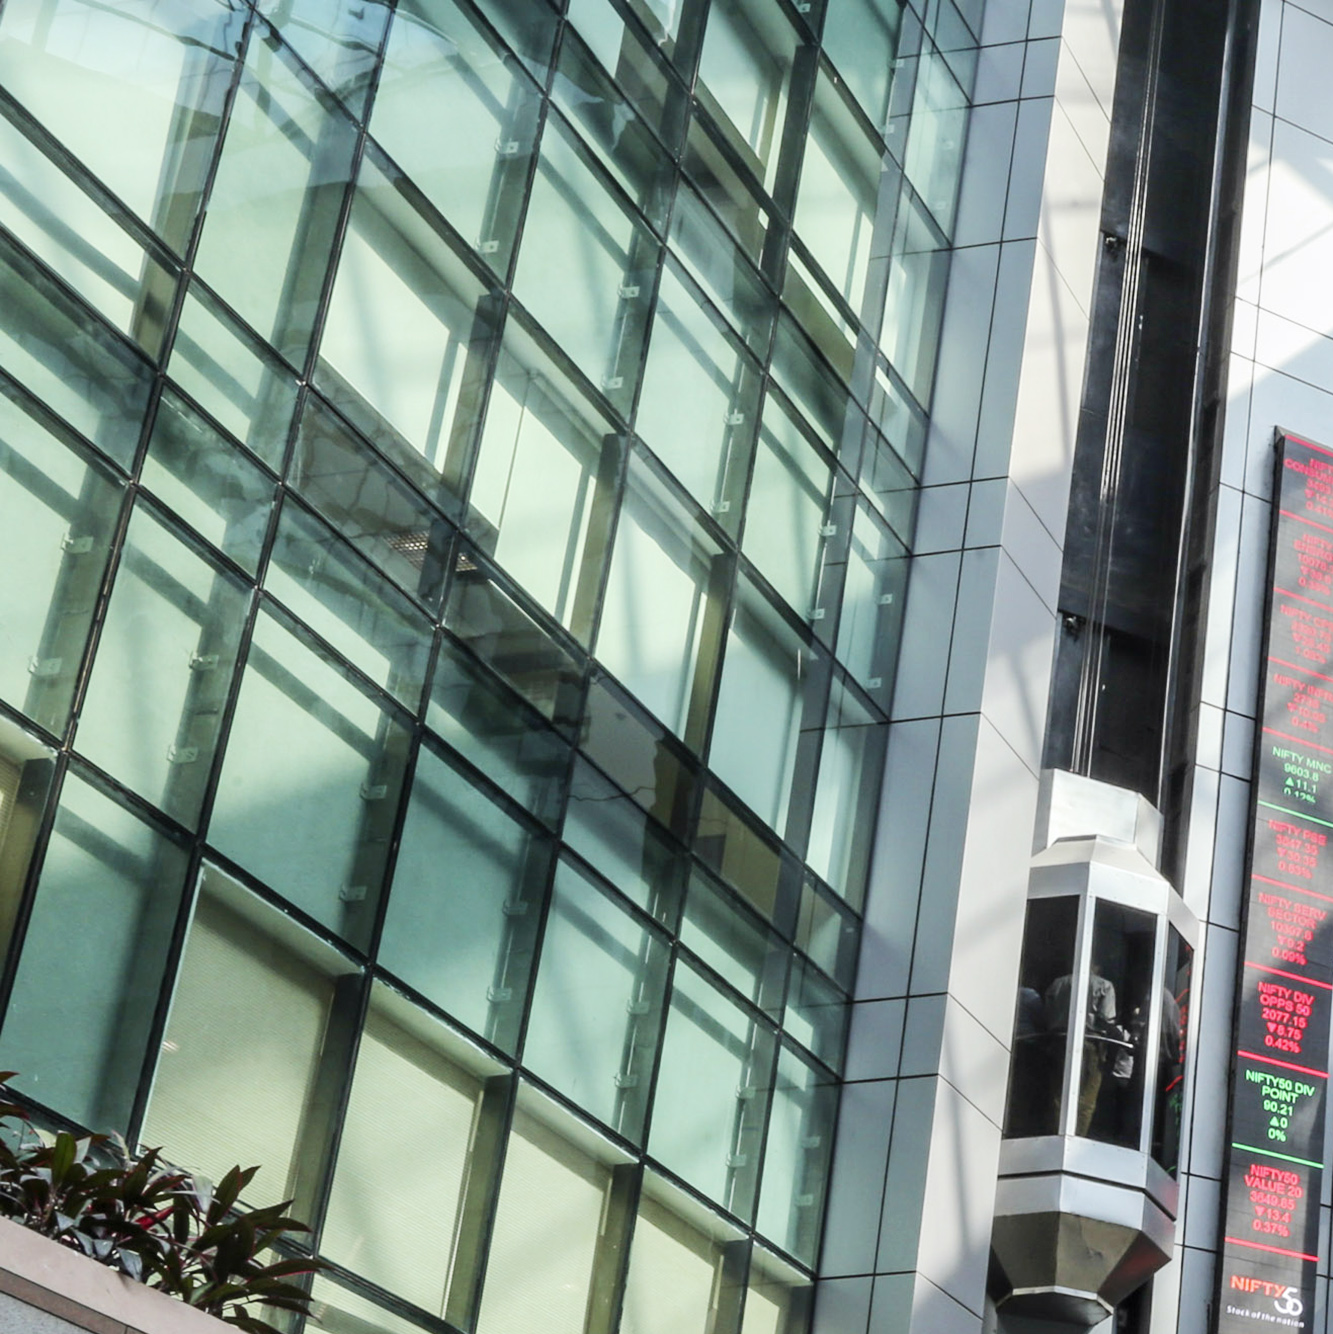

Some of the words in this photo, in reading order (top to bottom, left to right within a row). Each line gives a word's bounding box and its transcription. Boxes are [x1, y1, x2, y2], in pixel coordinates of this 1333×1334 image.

[1271, 748, 1302, 761] NIFTY
[1305, 760, 1331, 773] MNC
[1283, 763, 1319, 781] 9603.8
[1294, 779, 1317, 791] 11.1
[1268, 820, 1300, 835] NIFTY
[1258, 894, 1290, 908] NIFTY
[1257, 982, 1292, 1000] NIFTY
[1293, 991, 1314, 1006] DIV
[1262, 993, 1294, 1011] OPPS
[1294, 1002, 1311, 1015] 50
[1261, 1008, 1307, 1028] 2077.15
[1263, 1034, 1301, 1053] 0.42%
[1244, 1069, 1293, 1092] NIFTY50
[1294, 1085, 1314, 1095] DIV
[1261, 1085, 1297, 1101] POINT
[1262, 1098, 1294, 1115] 90.21
[1280, 1116, 1288, 1129] 0
[1266, 1127, 1287, 1141] 0%
[1249, 1164, 1300, 1185] NIFTY50
[1245, 1174, 1287, 1192] VALUE
[1287, 1183, 1301, 1195] 20
[1265, 1207, 1291, 1223] 13.4
[1251, 1218, 1290, 1237] 0.37%
[1230, 1275, 1286, 1299] NIFTY
[1273, 1286, 1303, 1317] 50
[1226, 1305, 1250, 1317] Stock
[1276, 1317, 1305, 1328] nation
